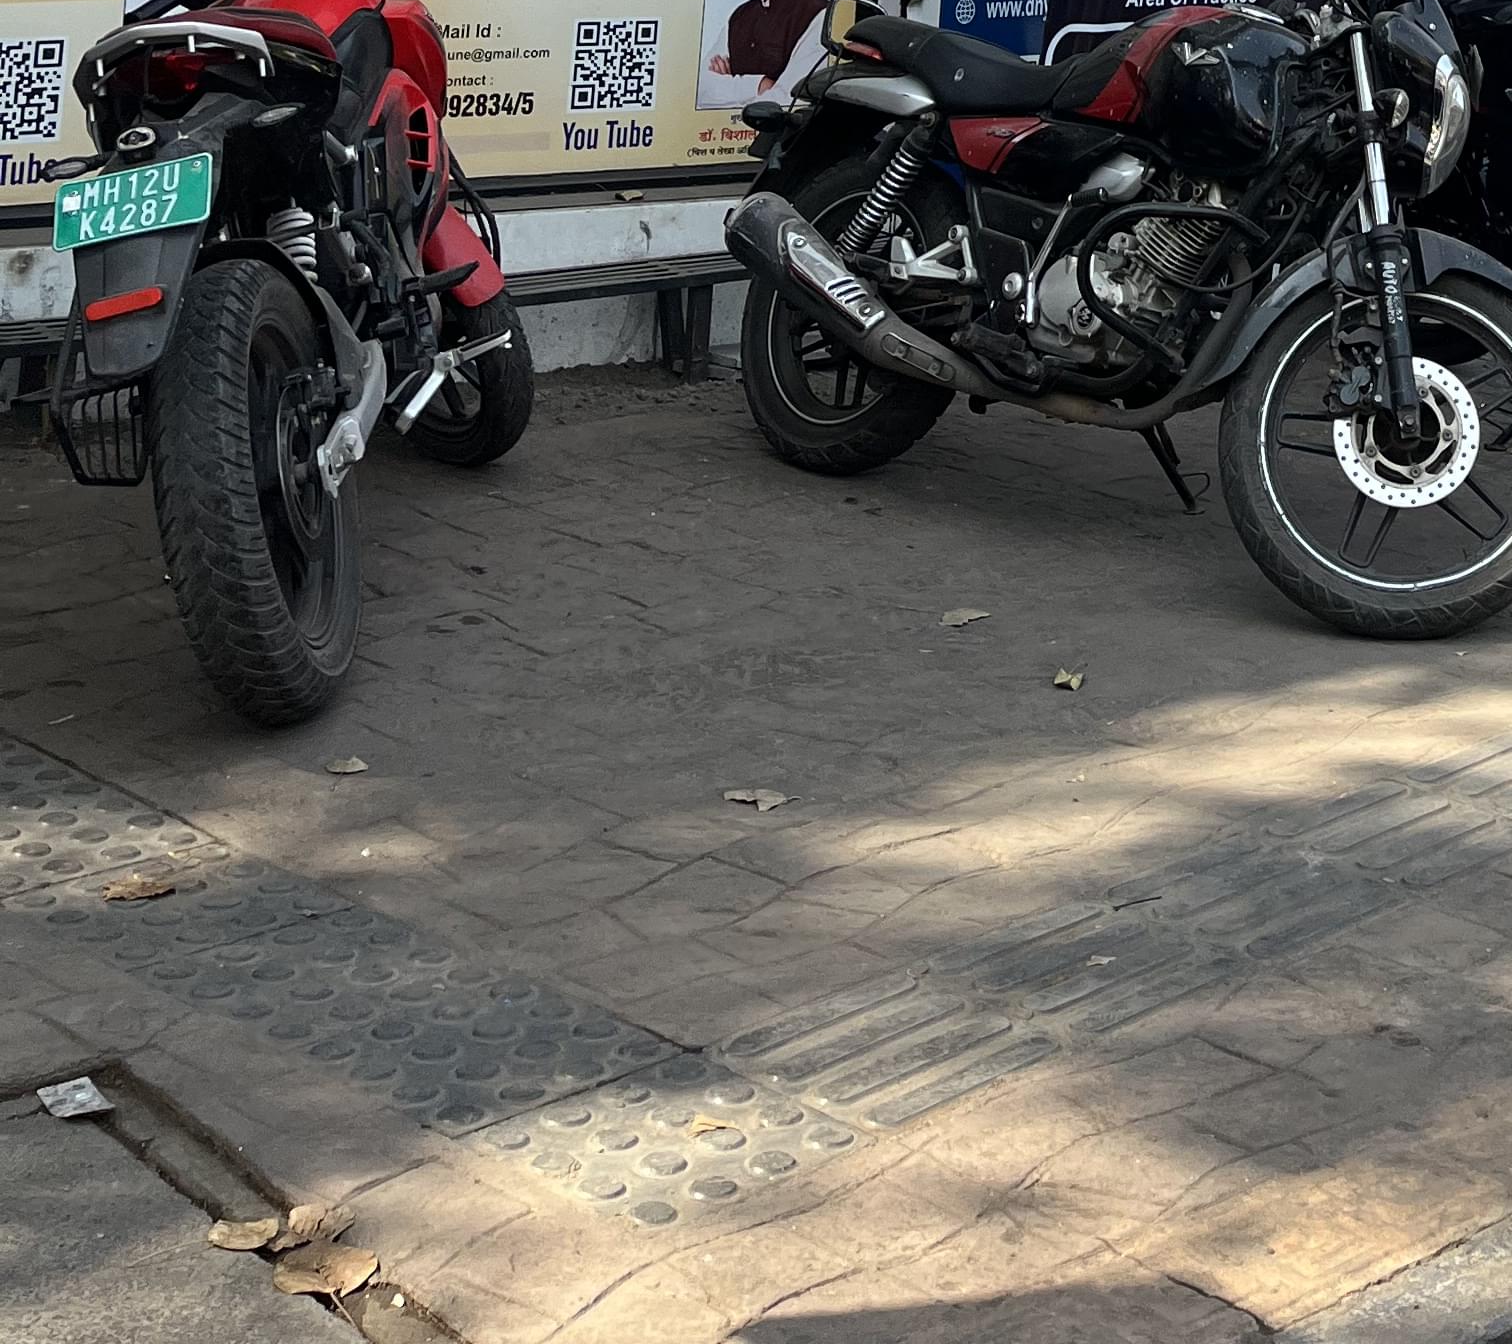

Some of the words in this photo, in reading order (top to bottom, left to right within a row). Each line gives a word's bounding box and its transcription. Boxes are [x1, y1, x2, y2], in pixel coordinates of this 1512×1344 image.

[563, 121, 600, 150] You
[606, 120, 653, 149] Tube
[83, 163, 181, 211] MH12U
[79, 194, 179, 242] K4287
